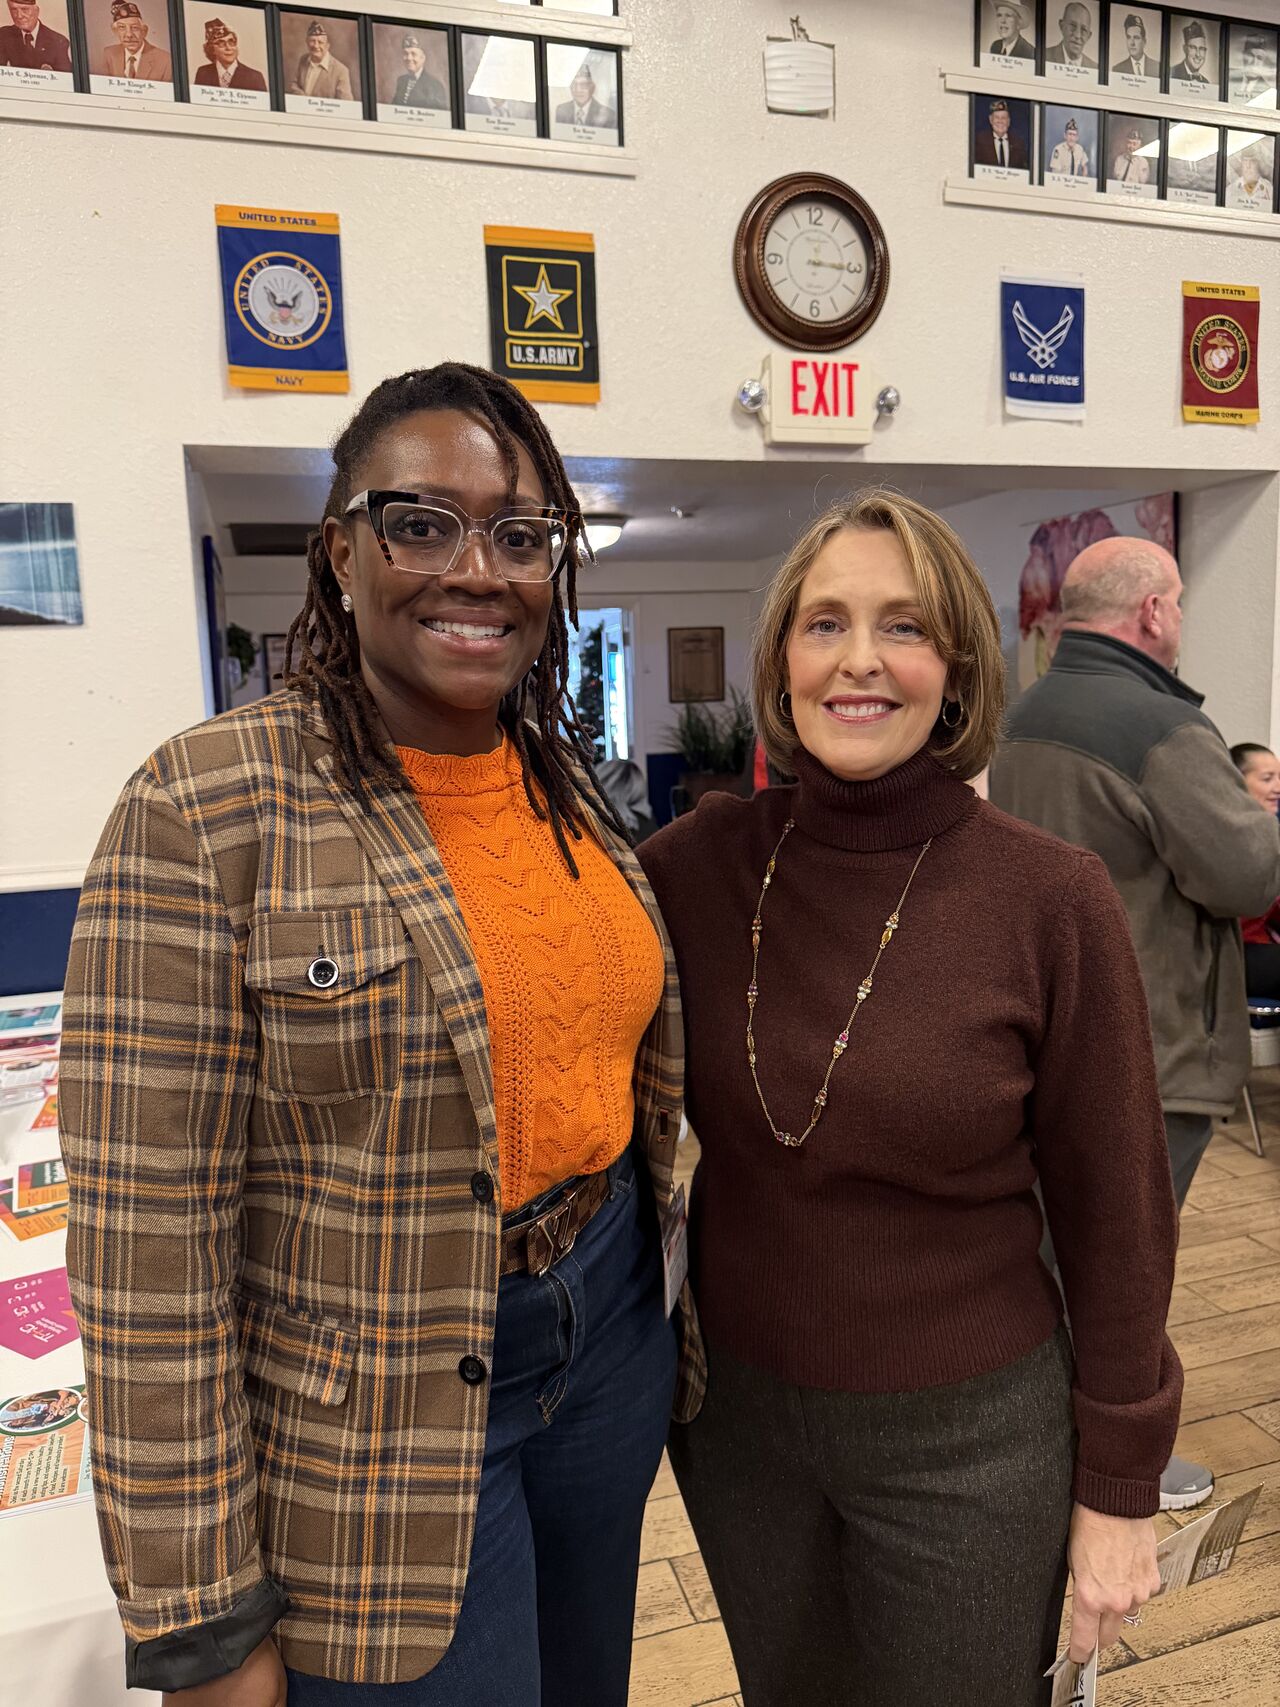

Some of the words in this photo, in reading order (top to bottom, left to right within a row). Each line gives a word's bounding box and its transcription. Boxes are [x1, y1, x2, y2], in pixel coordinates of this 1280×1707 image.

[238, 212, 276, 222] UNITED
[280, 216, 317, 226] STATES
[806, 207, 824, 226] 12
[846, 262, 862, 274] 3
[239, 259, 270, 312] UNITED
[295, 261, 327, 314] STATES
[1196, 286, 1220, 294] UNITED
[1221, 288, 1246, 296] STATES
[810, 300, 820, 318] 6
[267, 332, 304, 344] NAVY
[275, 375, 304, 386] NAVY
[1009, 371, 1028, 383] U.S.
[1028, 373, 1046, 384] AIR
[1046, 374, 1080, 386] FORCE
[791, 360, 859, 418] EXIT
